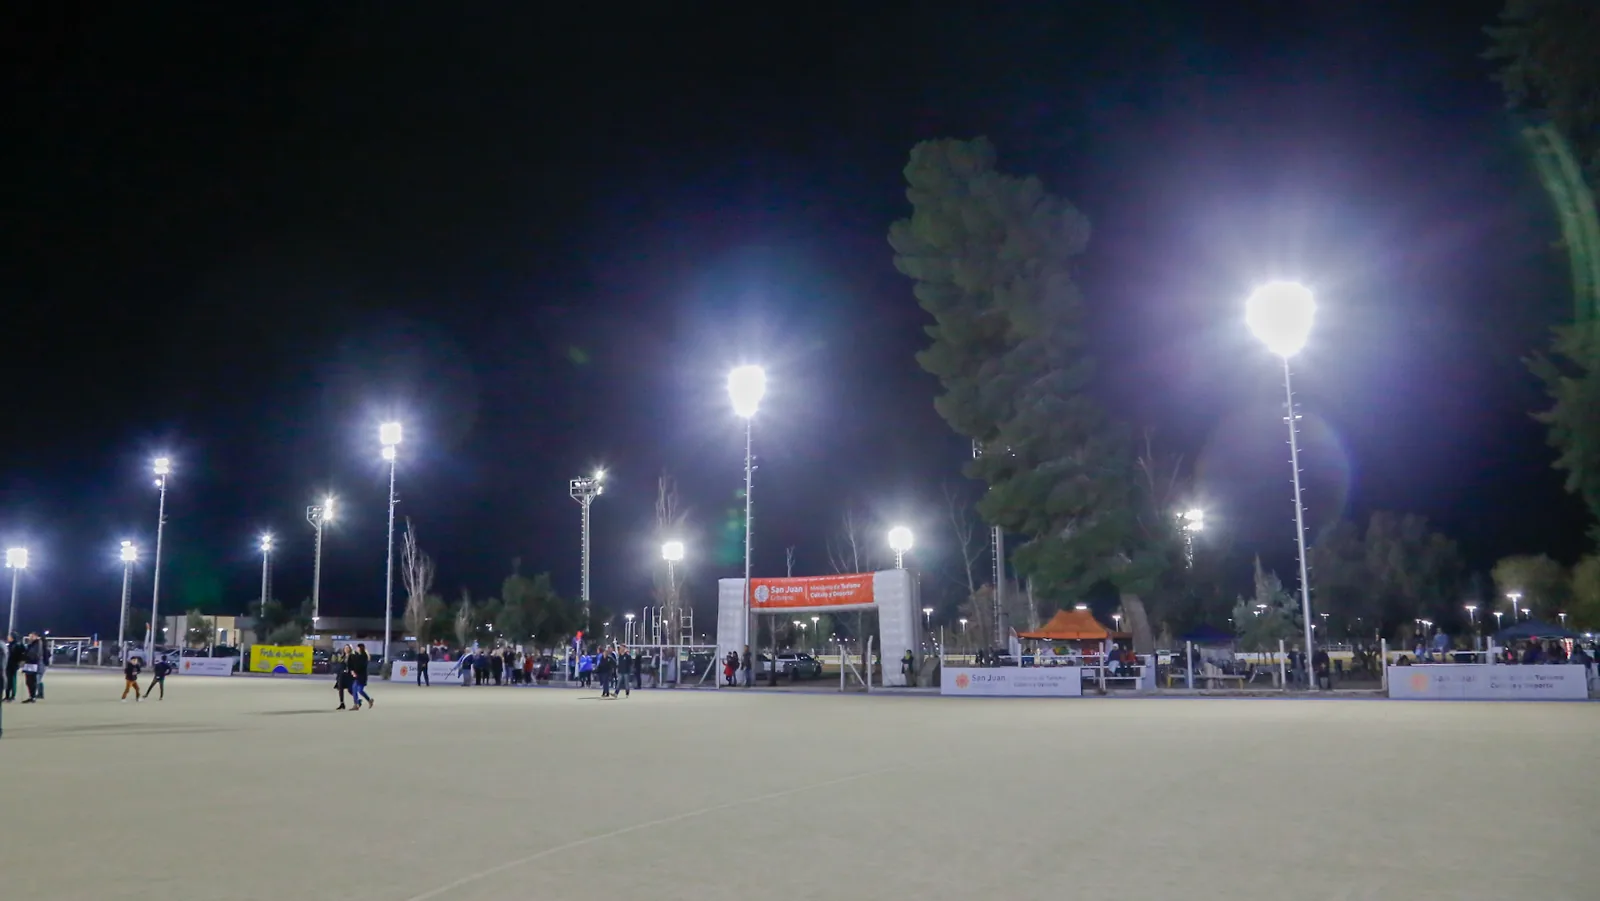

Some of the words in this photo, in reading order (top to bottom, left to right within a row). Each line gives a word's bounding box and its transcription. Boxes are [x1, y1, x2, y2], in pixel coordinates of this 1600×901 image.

[770, 586, 786, 594] San
[787, 585, 803, 593] Juan
[972, 674, 986, 682] San
[987, 674, 1006, 682] Juan
